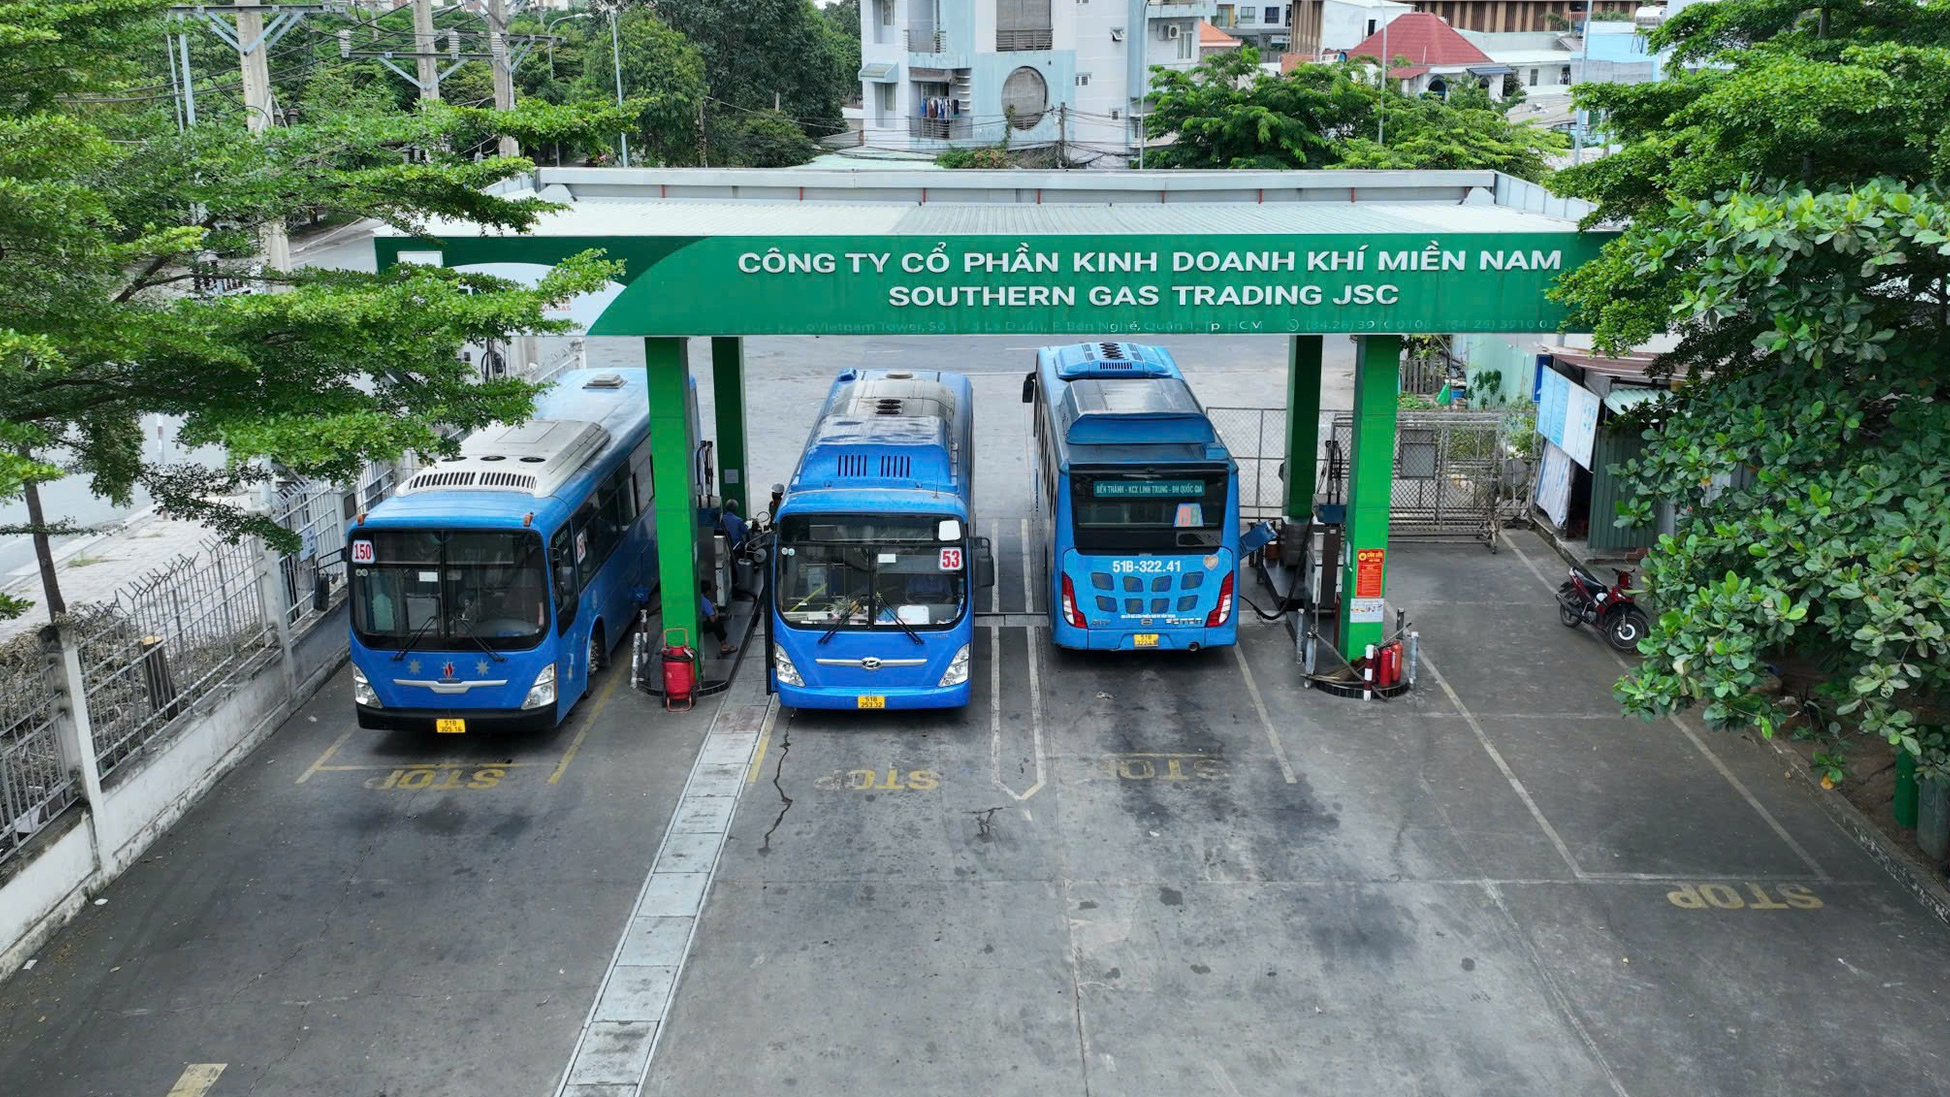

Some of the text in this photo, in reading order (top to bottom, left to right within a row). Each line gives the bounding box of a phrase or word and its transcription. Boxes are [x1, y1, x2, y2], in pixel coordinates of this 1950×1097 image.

[738, 240, 1562, 273] CÔNG TY CỔ PHẦN KINH DOANH KHÍ MIỀN NAM
[888, 285, 1399, 307] SOUTHERN GAS TRADING JSC
[354, 543, 372, 561] 150
[942, 550, 960, 568] 53
[1112, 560, 1181, 573] 51B-322.41
[363, 768, 505, 790] STOP
[1666, 883, 1824, 910] STOP
